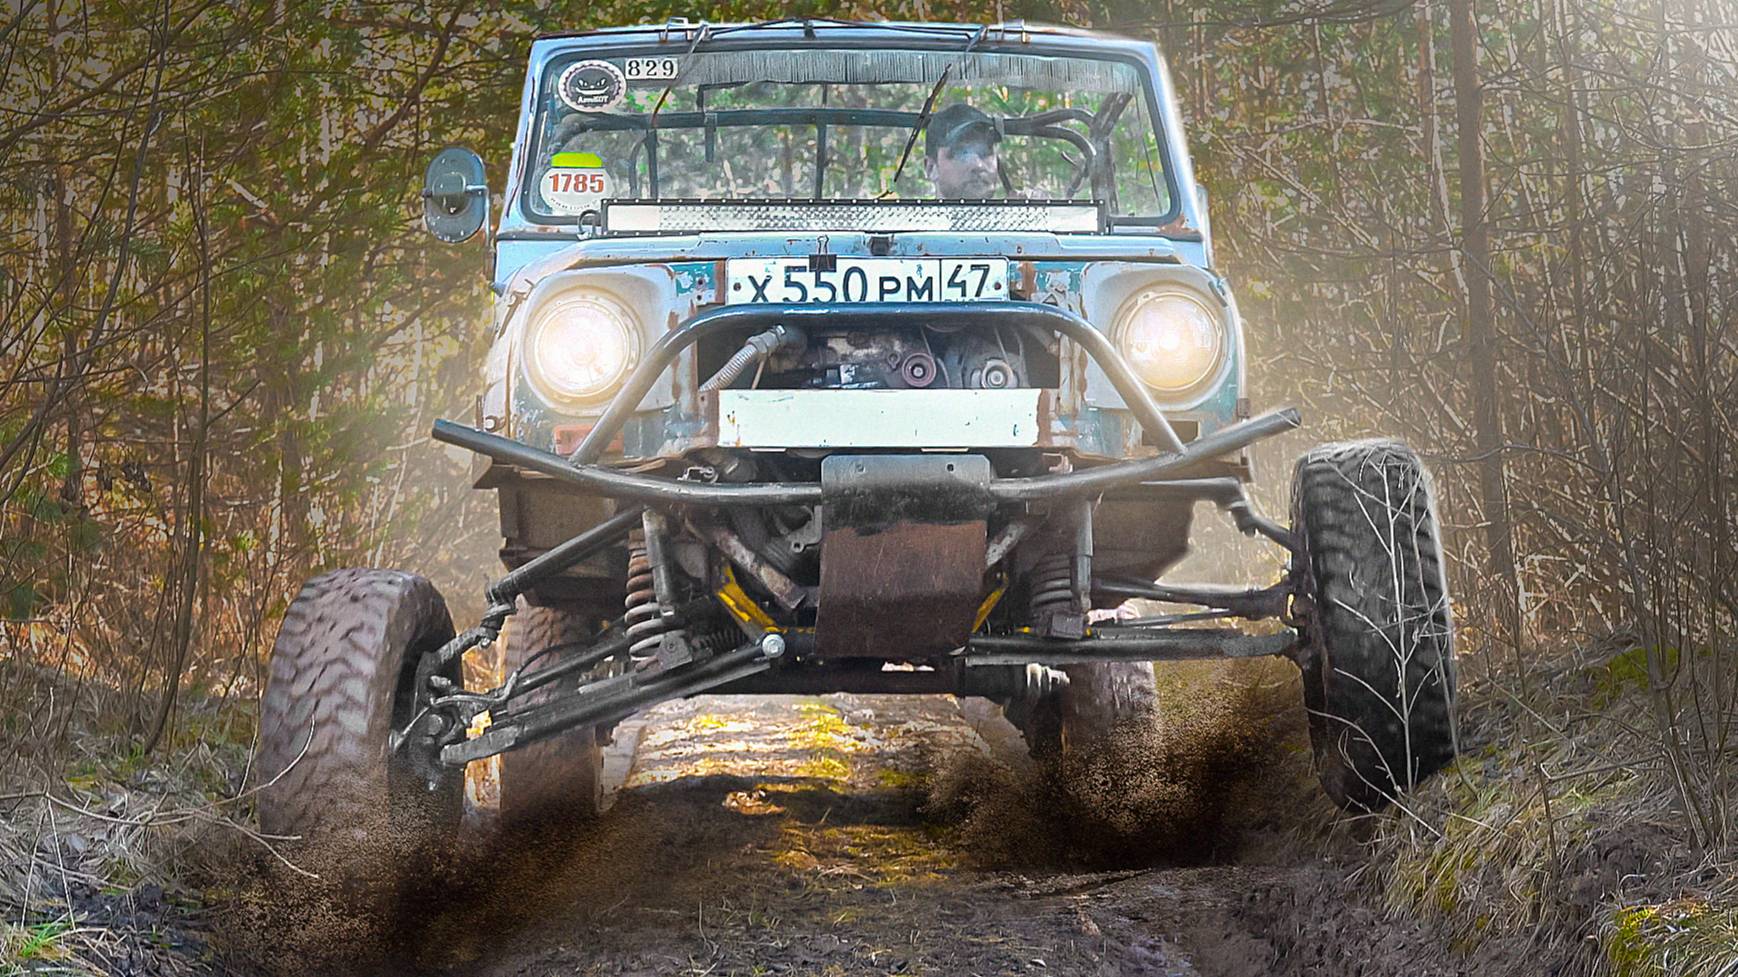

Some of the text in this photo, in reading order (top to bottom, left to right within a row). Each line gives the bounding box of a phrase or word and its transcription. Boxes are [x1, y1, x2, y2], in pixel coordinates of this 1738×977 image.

[627, 59, 675, 77] 829
[549, 172, 604, 194] 1785
[947, 263, 992, 298] 47
